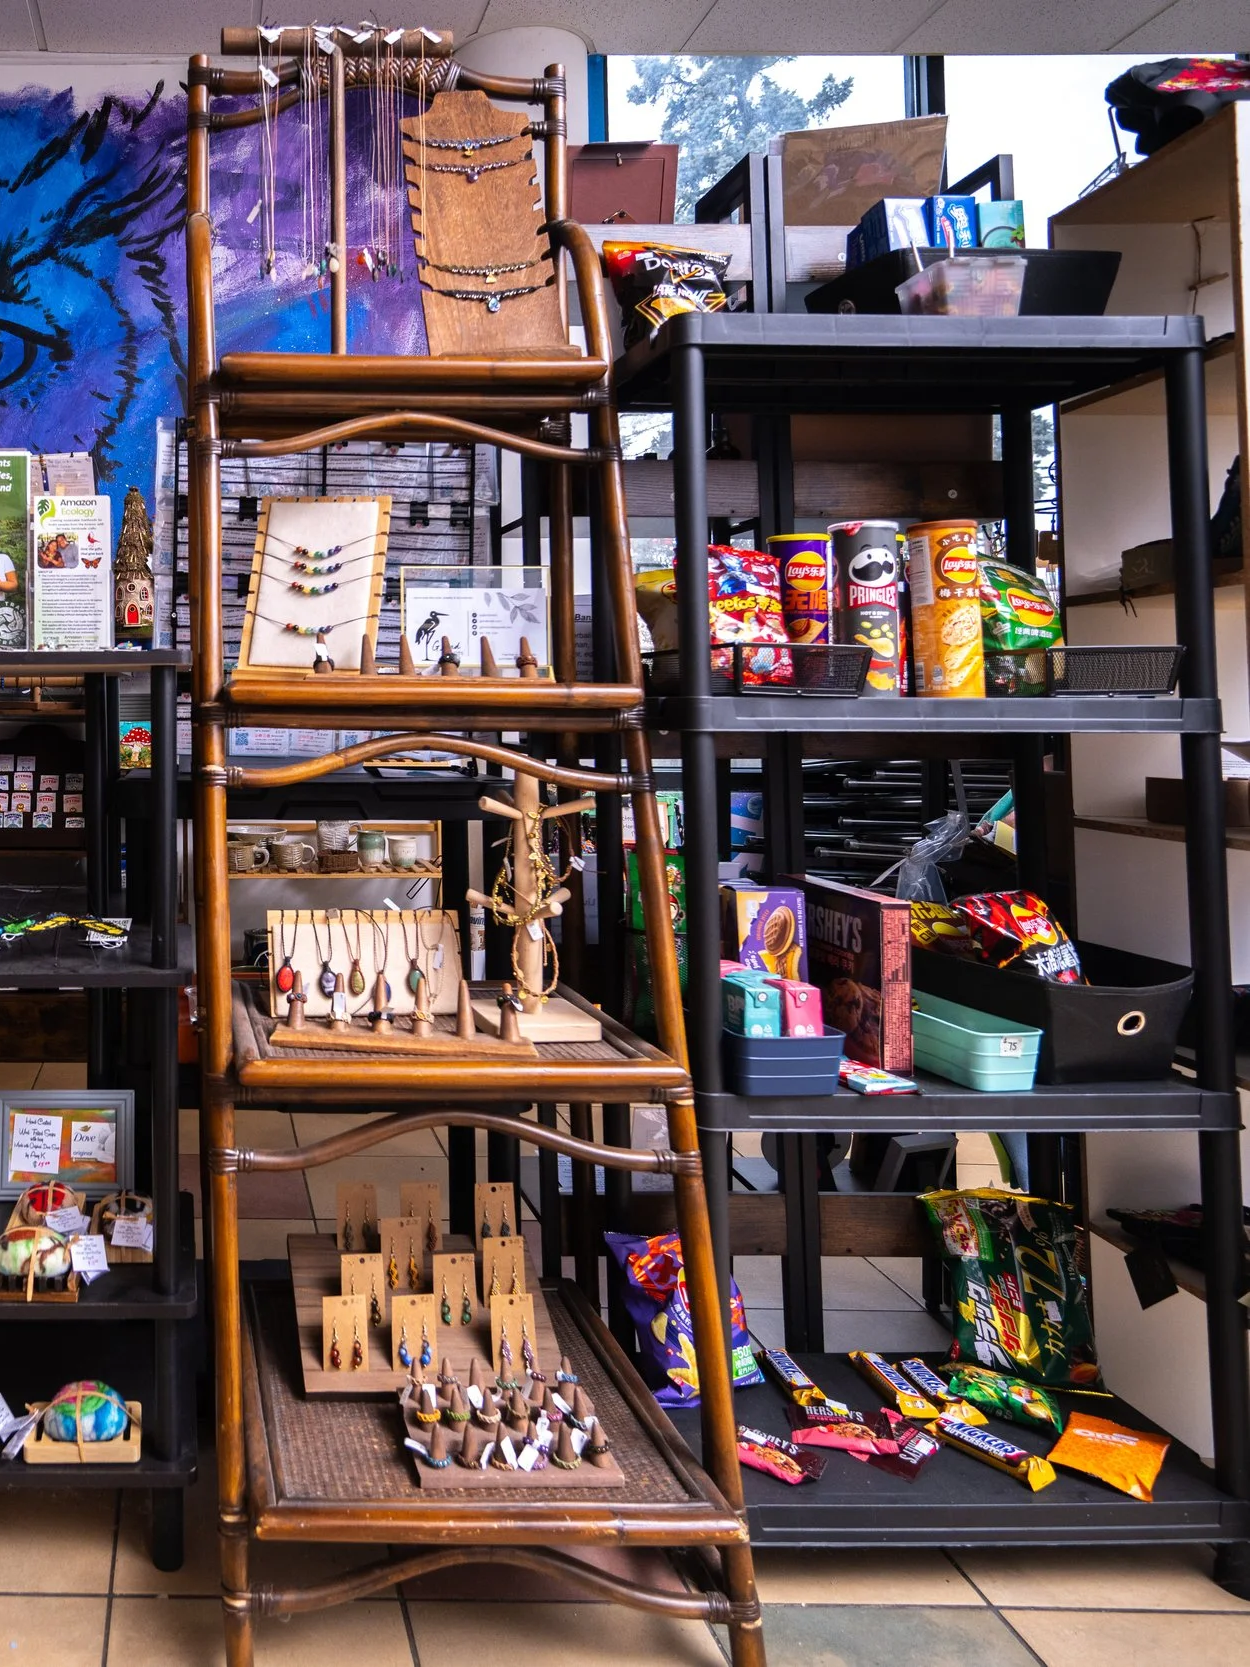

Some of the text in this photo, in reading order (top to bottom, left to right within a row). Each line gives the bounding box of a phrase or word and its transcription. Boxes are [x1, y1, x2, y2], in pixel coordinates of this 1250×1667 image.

[644, 257, 716, 280] Doritos
[61, 507, 95, 517] Ecology
[850, 585, 896, 607] PRINGLES
[806, 903, 863, 954] RSHEY'S
[73, 1132, 96, 1143] Dove
[73, 1150, 93, 1158] original
[944, 1425, 1007, 1458] BUTTERSCOTCH
[951, 1421, 1018, 1454] NICKERS
